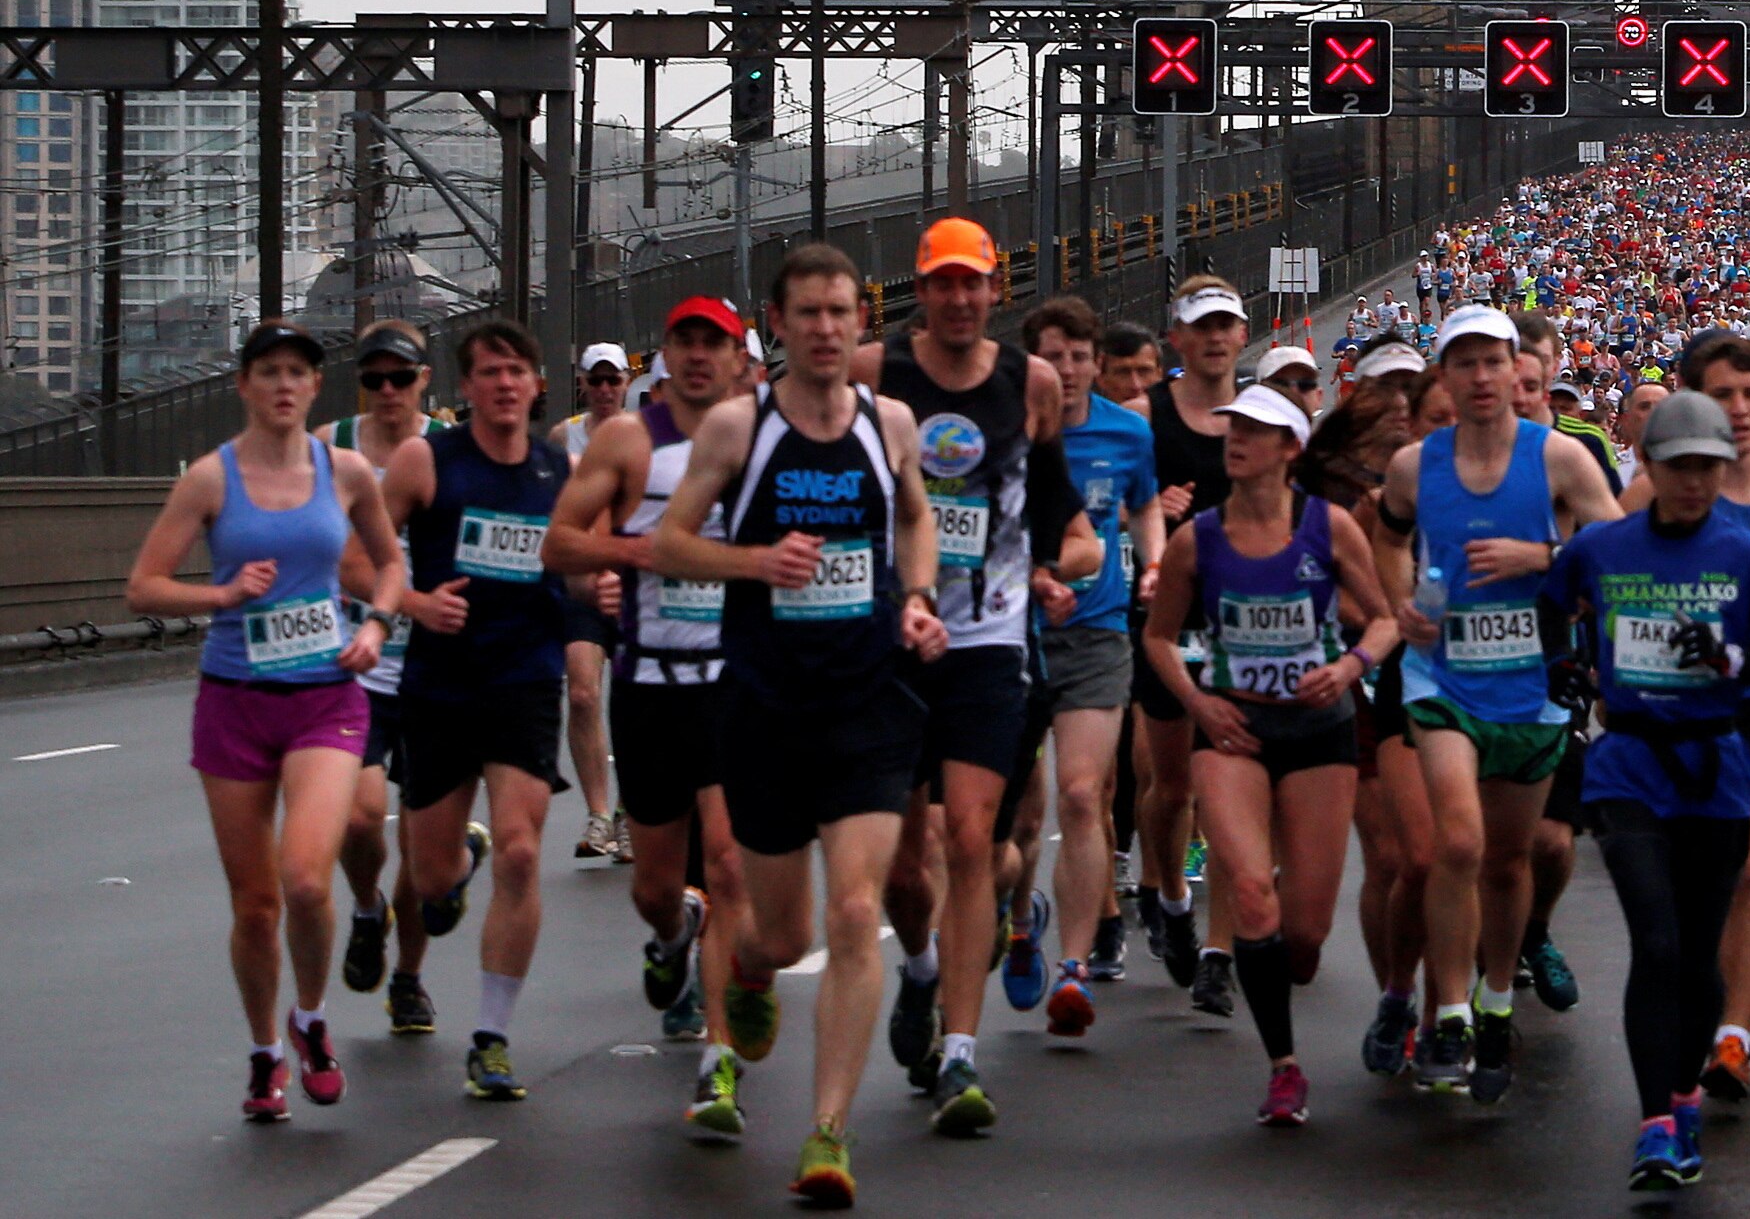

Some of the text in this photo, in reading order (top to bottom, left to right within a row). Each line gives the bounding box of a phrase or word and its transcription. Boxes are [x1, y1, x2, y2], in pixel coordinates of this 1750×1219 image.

[1169, 92, 1177, 111] 1
[1342, 93, 1359, 113] 2
[1518, 94, 1535, 113] 3
[1694, 94, 1714, 114] 4
[774, 470, 865, 502] SWEAT
[775, 505, 867, 525] SYDNEY
[271, 605, 334, 641] 10686
[1248, 605, 1305, 629] 10714
[1469, 612, 1533, 641] 10343
